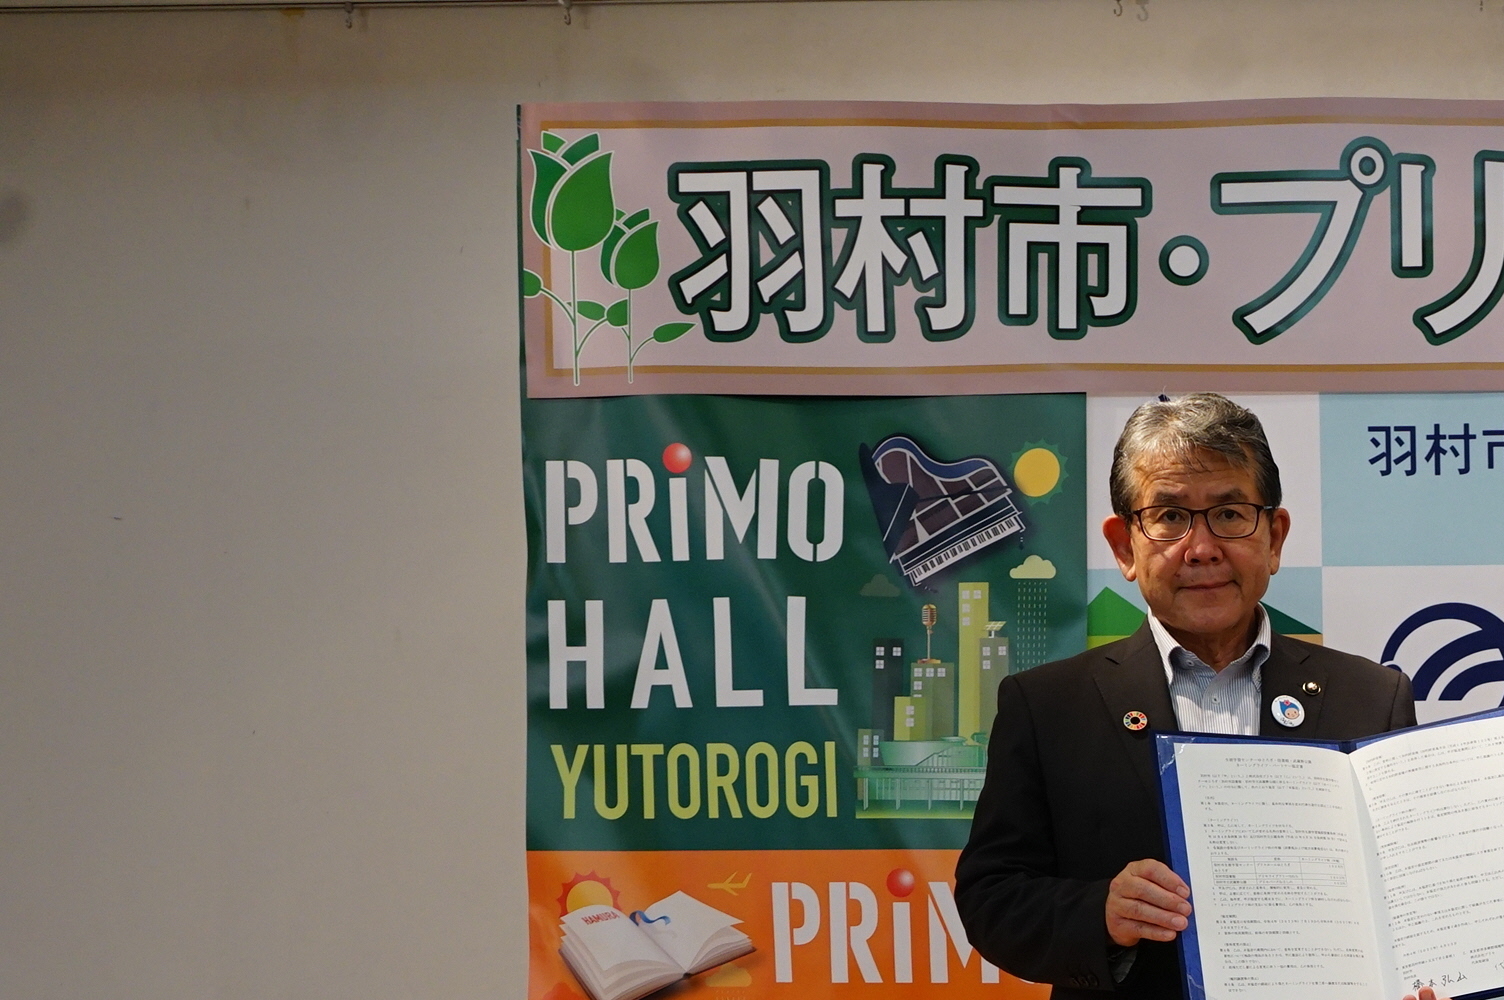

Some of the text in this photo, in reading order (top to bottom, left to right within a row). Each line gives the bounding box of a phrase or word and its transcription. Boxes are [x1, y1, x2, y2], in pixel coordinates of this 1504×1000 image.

[547, 595, 839, 710] HALL
[550, 740, 838, 821] YUTOROGI
[581, 910, 620, 926] HAMURA
[771, 868, 1036, 985] PRiM
